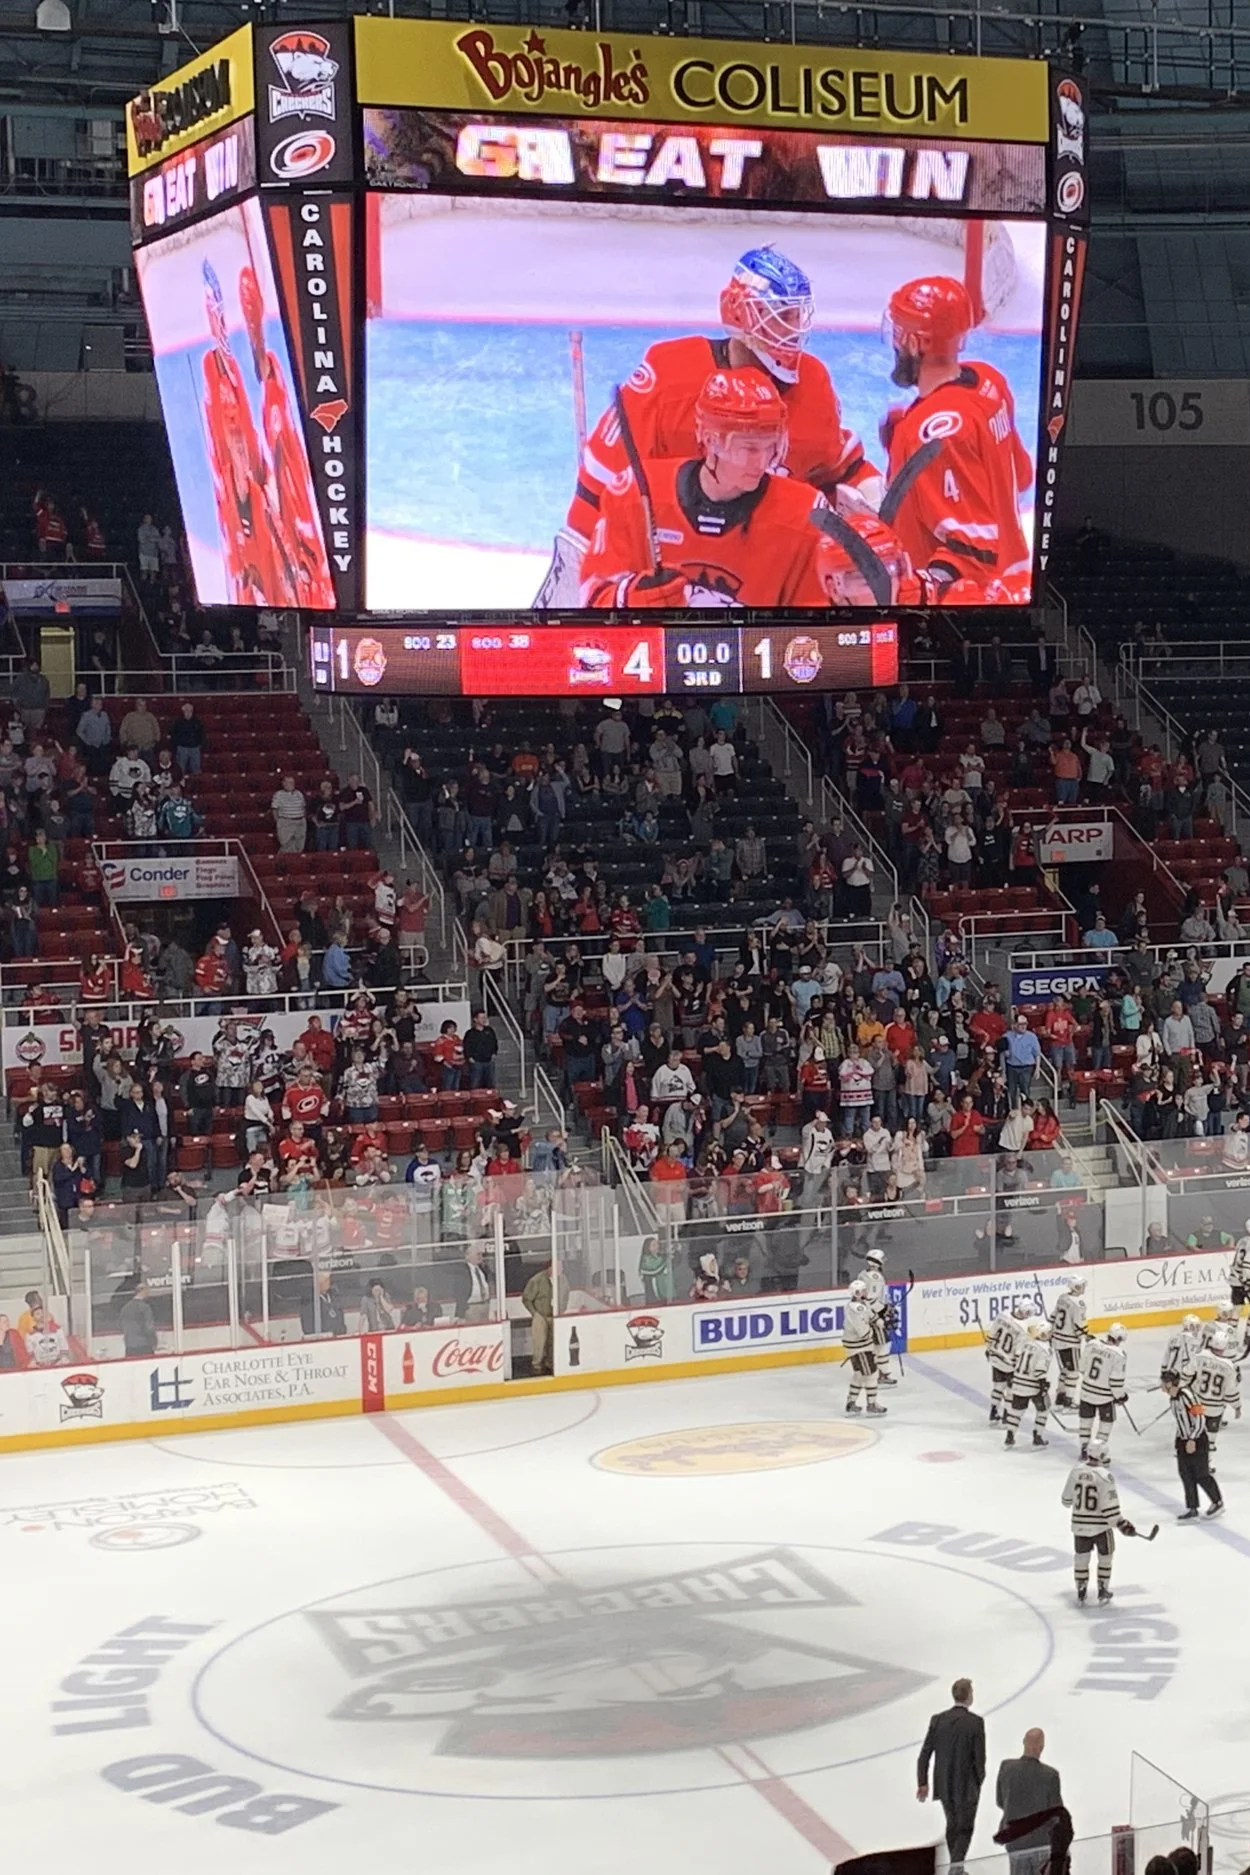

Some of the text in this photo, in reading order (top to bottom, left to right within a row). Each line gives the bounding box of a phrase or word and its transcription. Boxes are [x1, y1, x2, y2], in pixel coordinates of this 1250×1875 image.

[672, 60, 970, 124] COLISEUM
[816, 144, 971, 200] WIN
[300, 203, 352, 573] CAROLINA HOCKEY
[1040, 236, 1076, 571] CAROLINA HOCKEY
[1130, 391, 1204, 431] 105
[943, 469, 960, 503] 4
[622, 640, 653, 684] 4
[677, 643, 731, 664] 00.0
[754, 638, 772, 680] 1
[683, 671, 723, 687] 3RD
[130, 867, 190, 882] Conder
[868, 1208, 905, 1220] verizon
[1004, 1196, 1040, 1208] verizon
[725, 1219, 765, 1233] verizon
[922, 1287, 943, 1299] Wet
[945, 1285, 970, 1297] Your
[973, 1280, 1012, 1294] Whistle
[960, 1296, 980, 1326] $1
[700, 1313, 774, 1345] BUD
[274, 1370, 289, 1384] &
[366, 1342, 378, 1394] CCM
[1088, 1357, 1103, 1380] 6
[1200, 1370, 1224, 1396] 39
[1074, 1483, 1099, 1512] 36
[866, 1518, 1077, 1574] BUD
[50, 1614, 217, 1737] LIGHT
[100, 1752, 347, 1837] BUD
